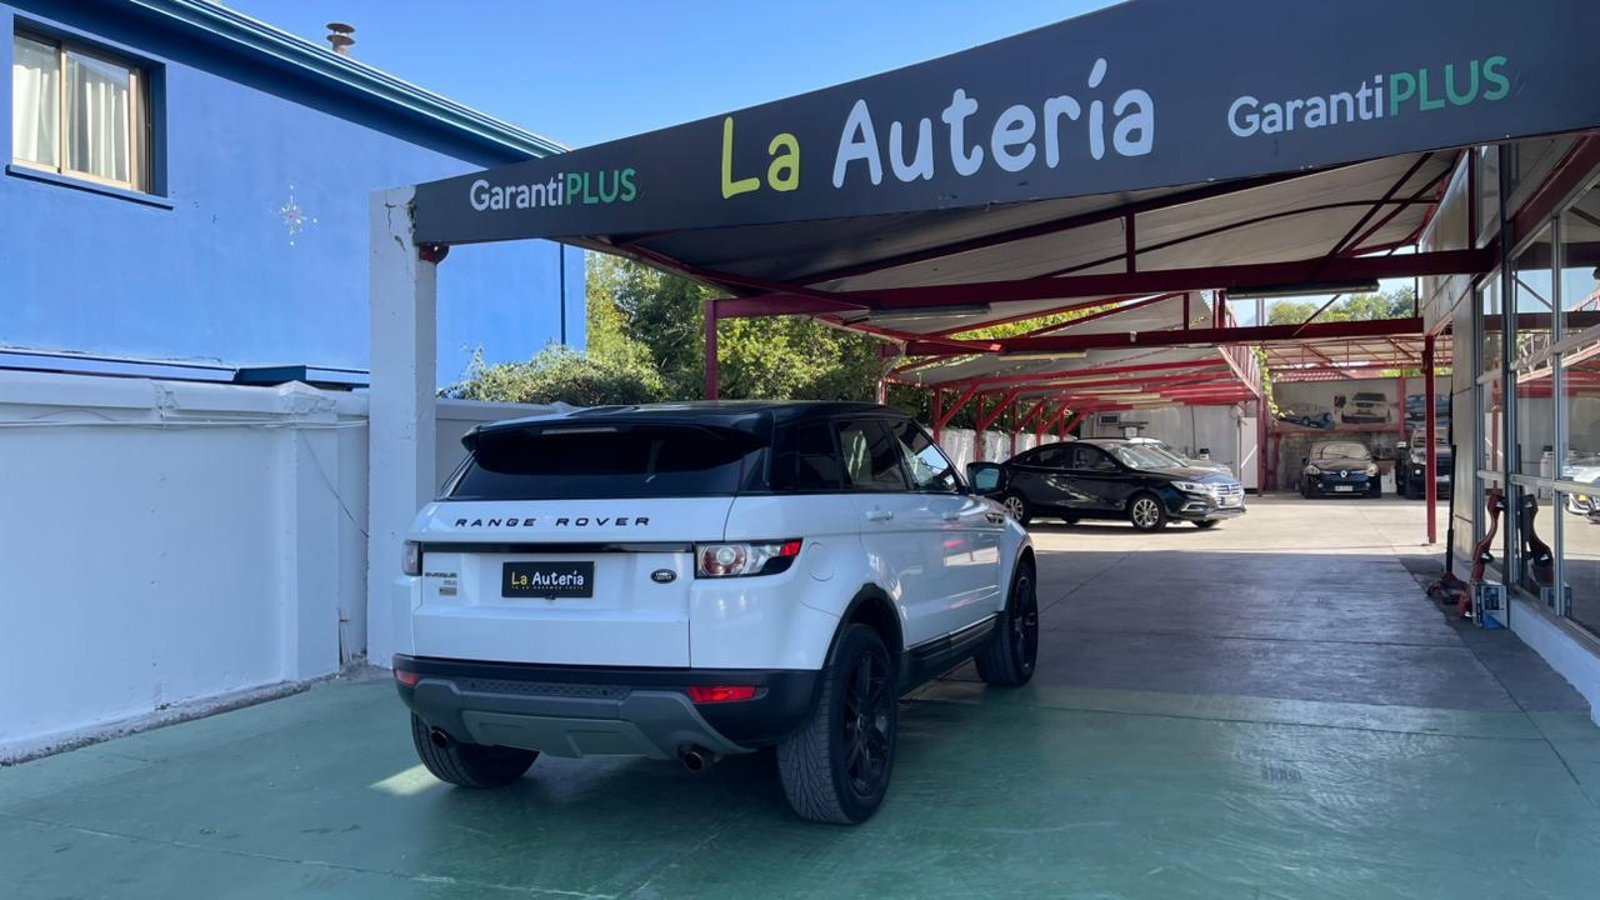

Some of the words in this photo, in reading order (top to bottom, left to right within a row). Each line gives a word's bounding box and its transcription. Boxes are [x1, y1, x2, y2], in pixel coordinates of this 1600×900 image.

[1228, 55, 1510, 138] GarantiPLUS
[721, 116, 800, 199] La
[832, 57, 1155, 189] Autería
[469, 167, 637, 212] GarantiPLUS
[455, 518, 537, 527] RANGE
[555, 517, 650, 527] ROVER
[511, 571, 528, 586] La
[531, 570, 584, 586] Autería
